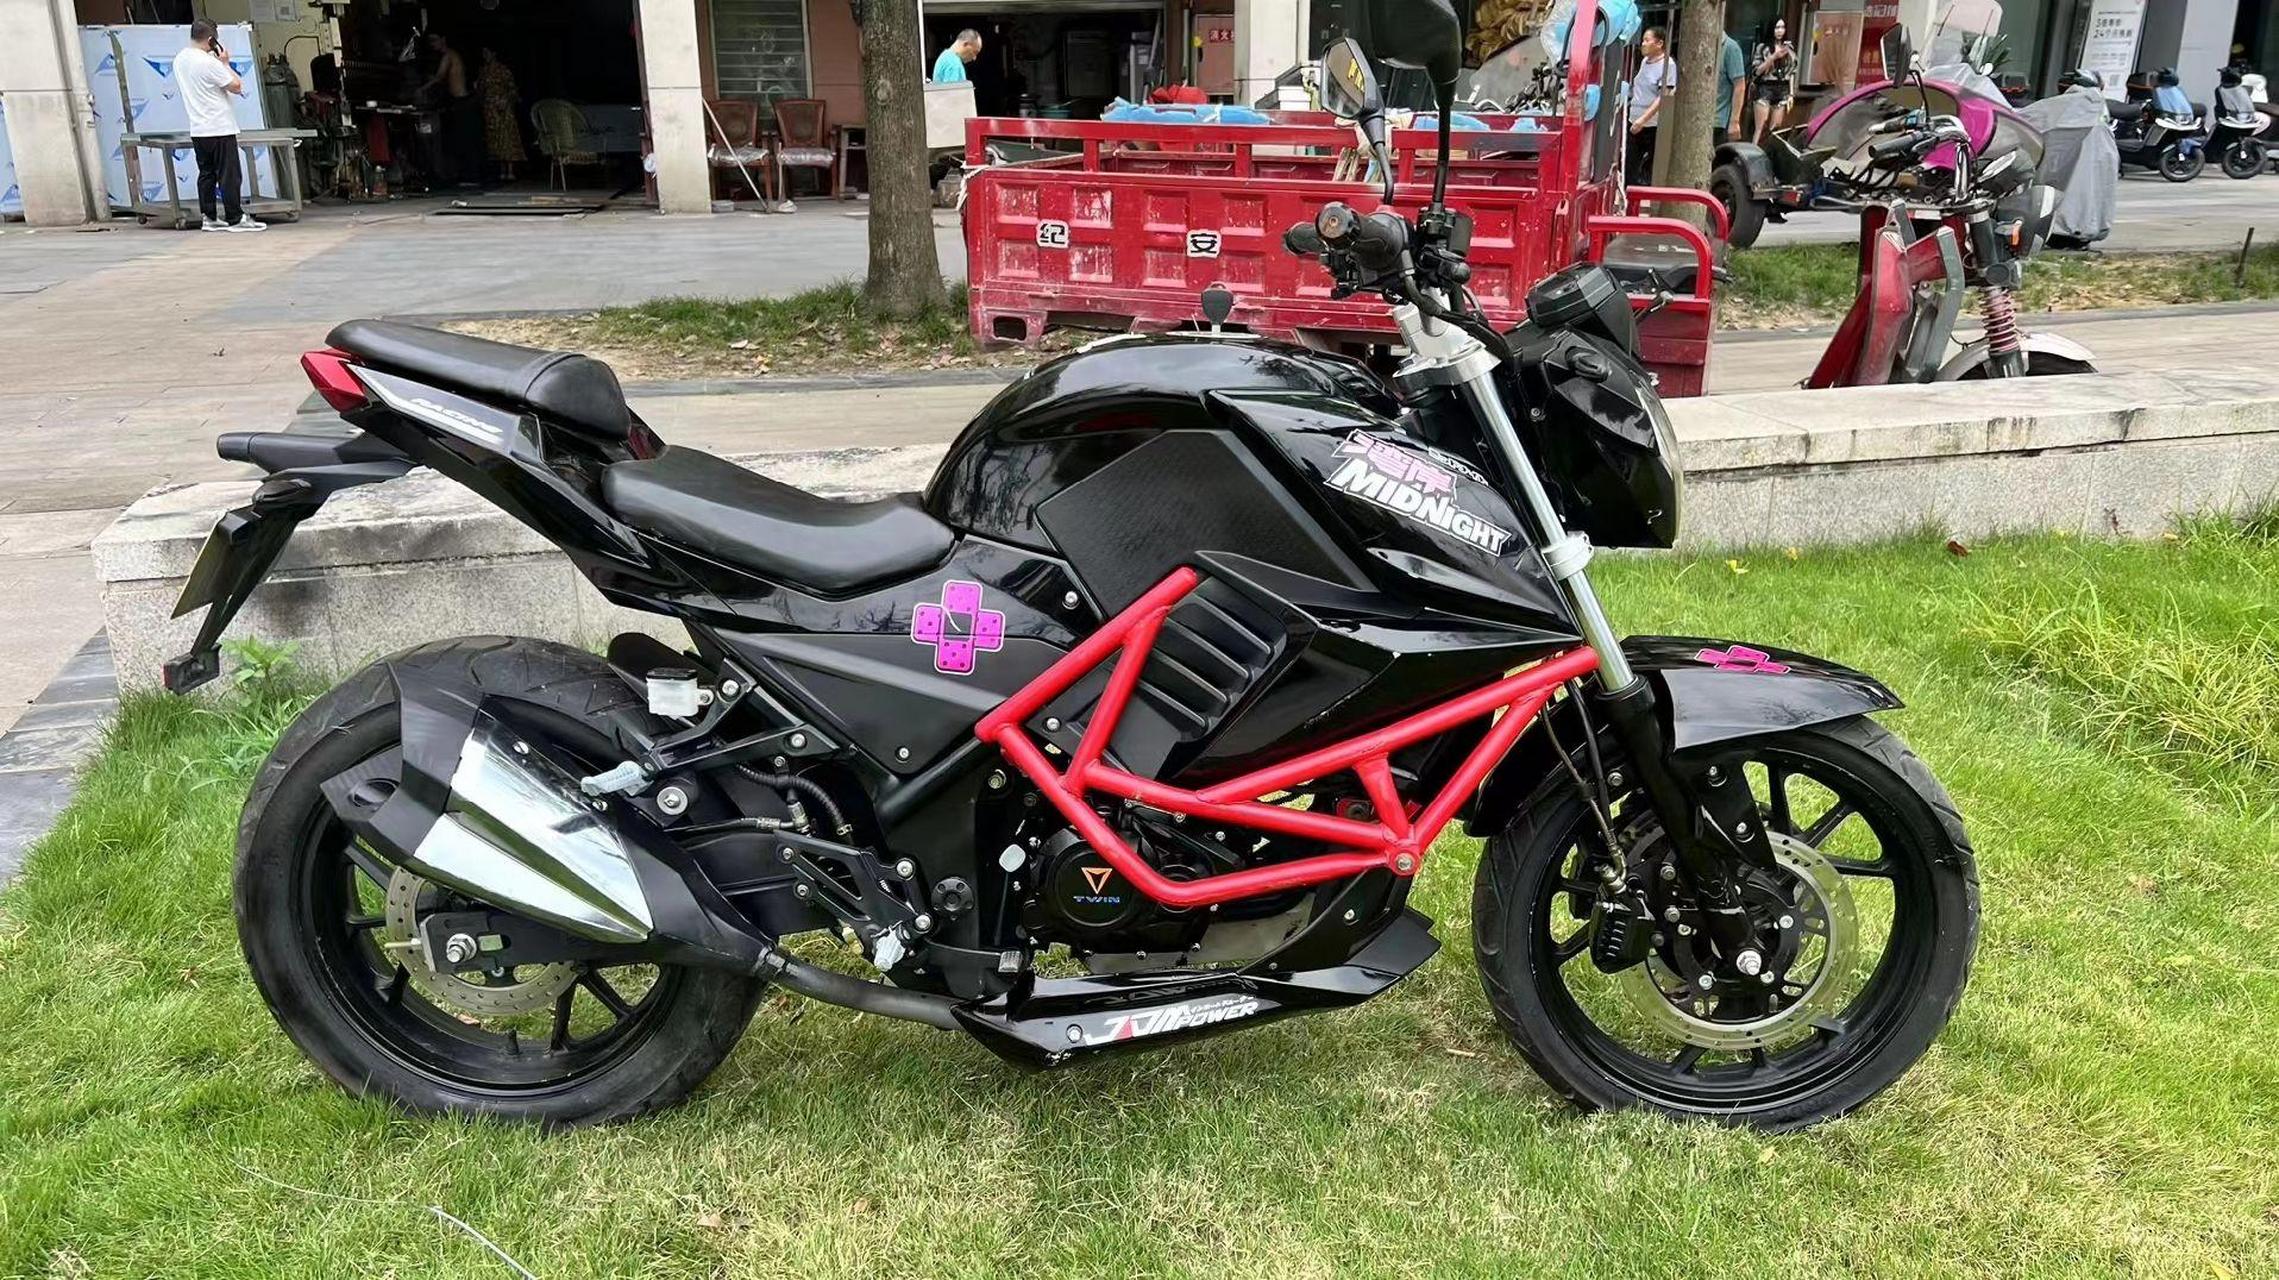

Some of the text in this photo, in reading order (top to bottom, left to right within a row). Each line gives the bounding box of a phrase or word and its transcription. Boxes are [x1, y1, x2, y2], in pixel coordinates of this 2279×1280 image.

[1209, 29, 1235, 41] 消火
[1038, 222, 1219, 256] 纪 安
[1072, 895, 1121, 904] TWIN
[1174, 1001, 1259, 1031] POWER
